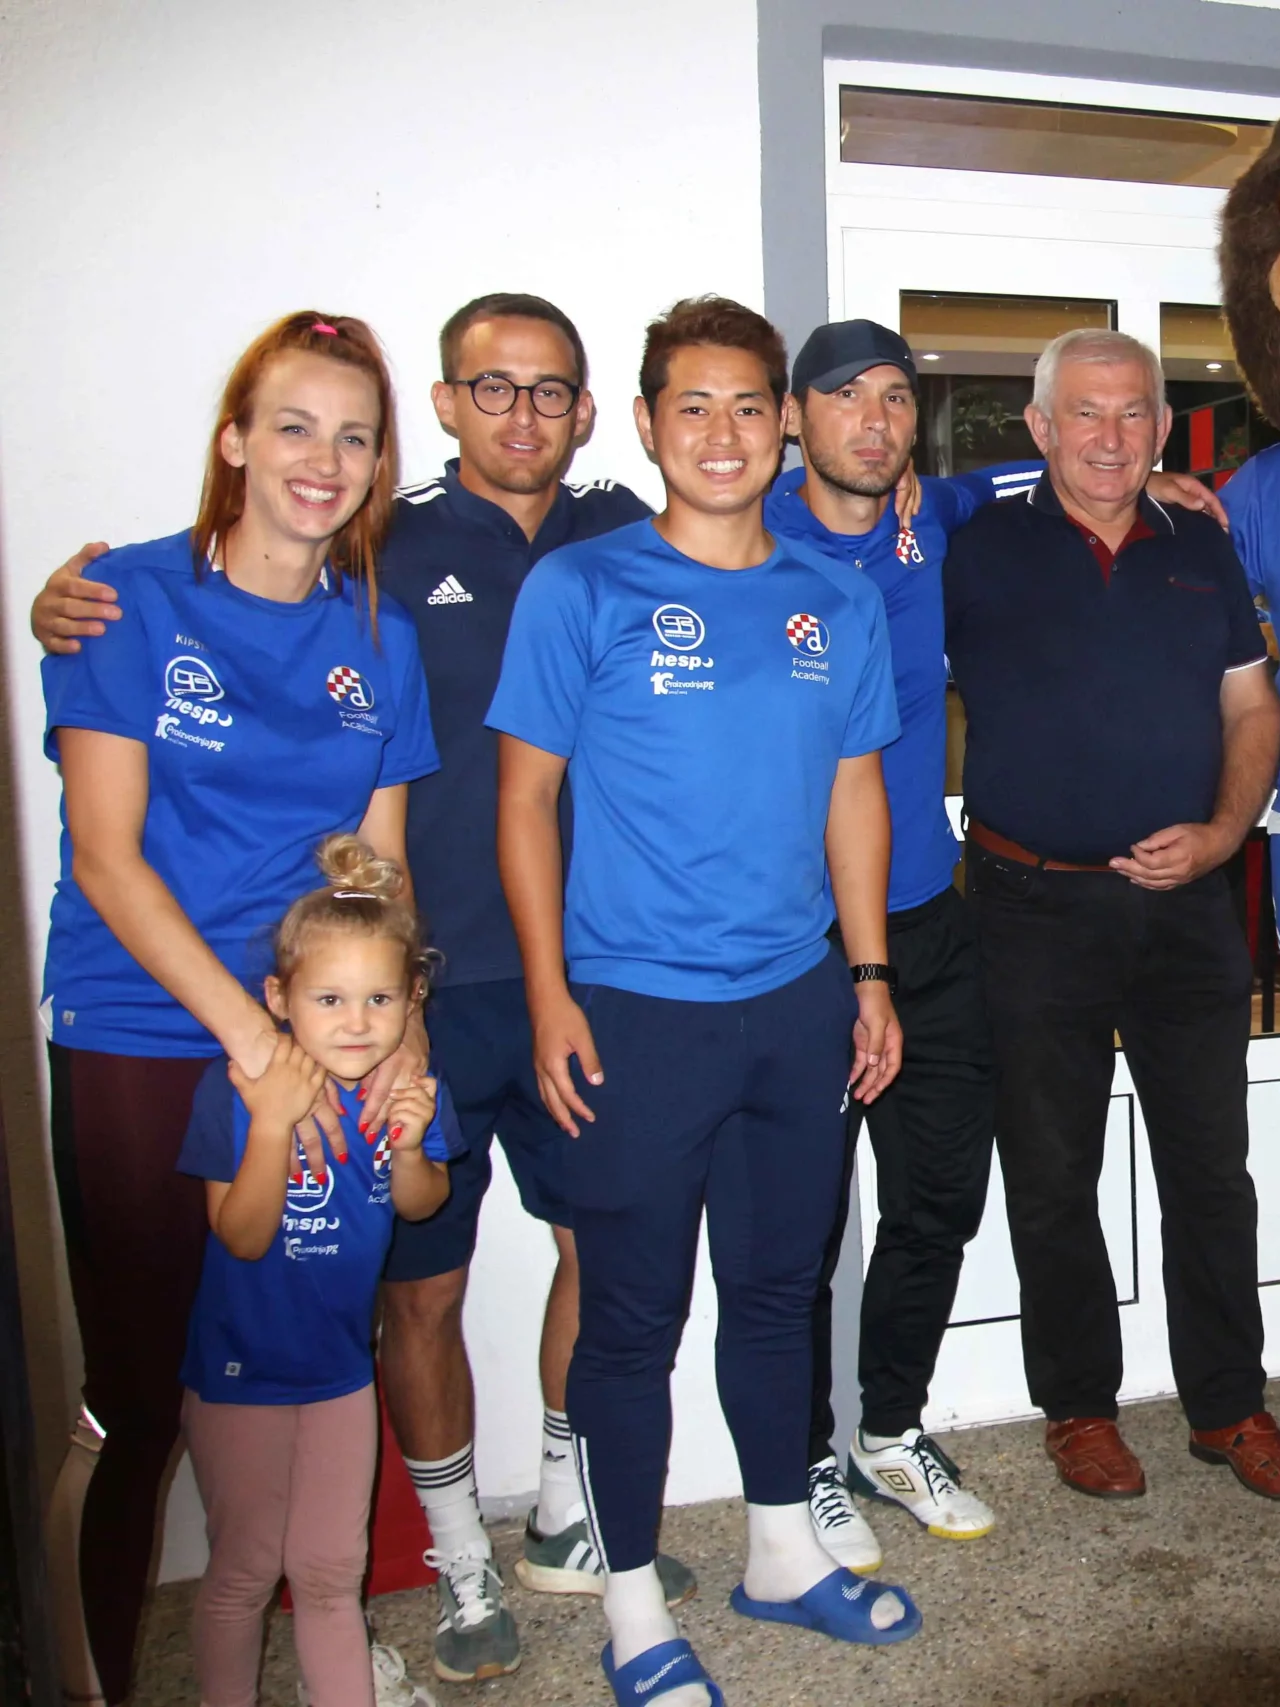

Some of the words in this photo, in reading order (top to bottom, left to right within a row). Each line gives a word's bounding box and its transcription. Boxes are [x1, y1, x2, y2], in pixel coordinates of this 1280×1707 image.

[427, 593, 473, 605] adidas
[176, 633, 209, 652] KIPST
[792, 657, 829, 671] Football
[790, 669, 830, 685] Academy
